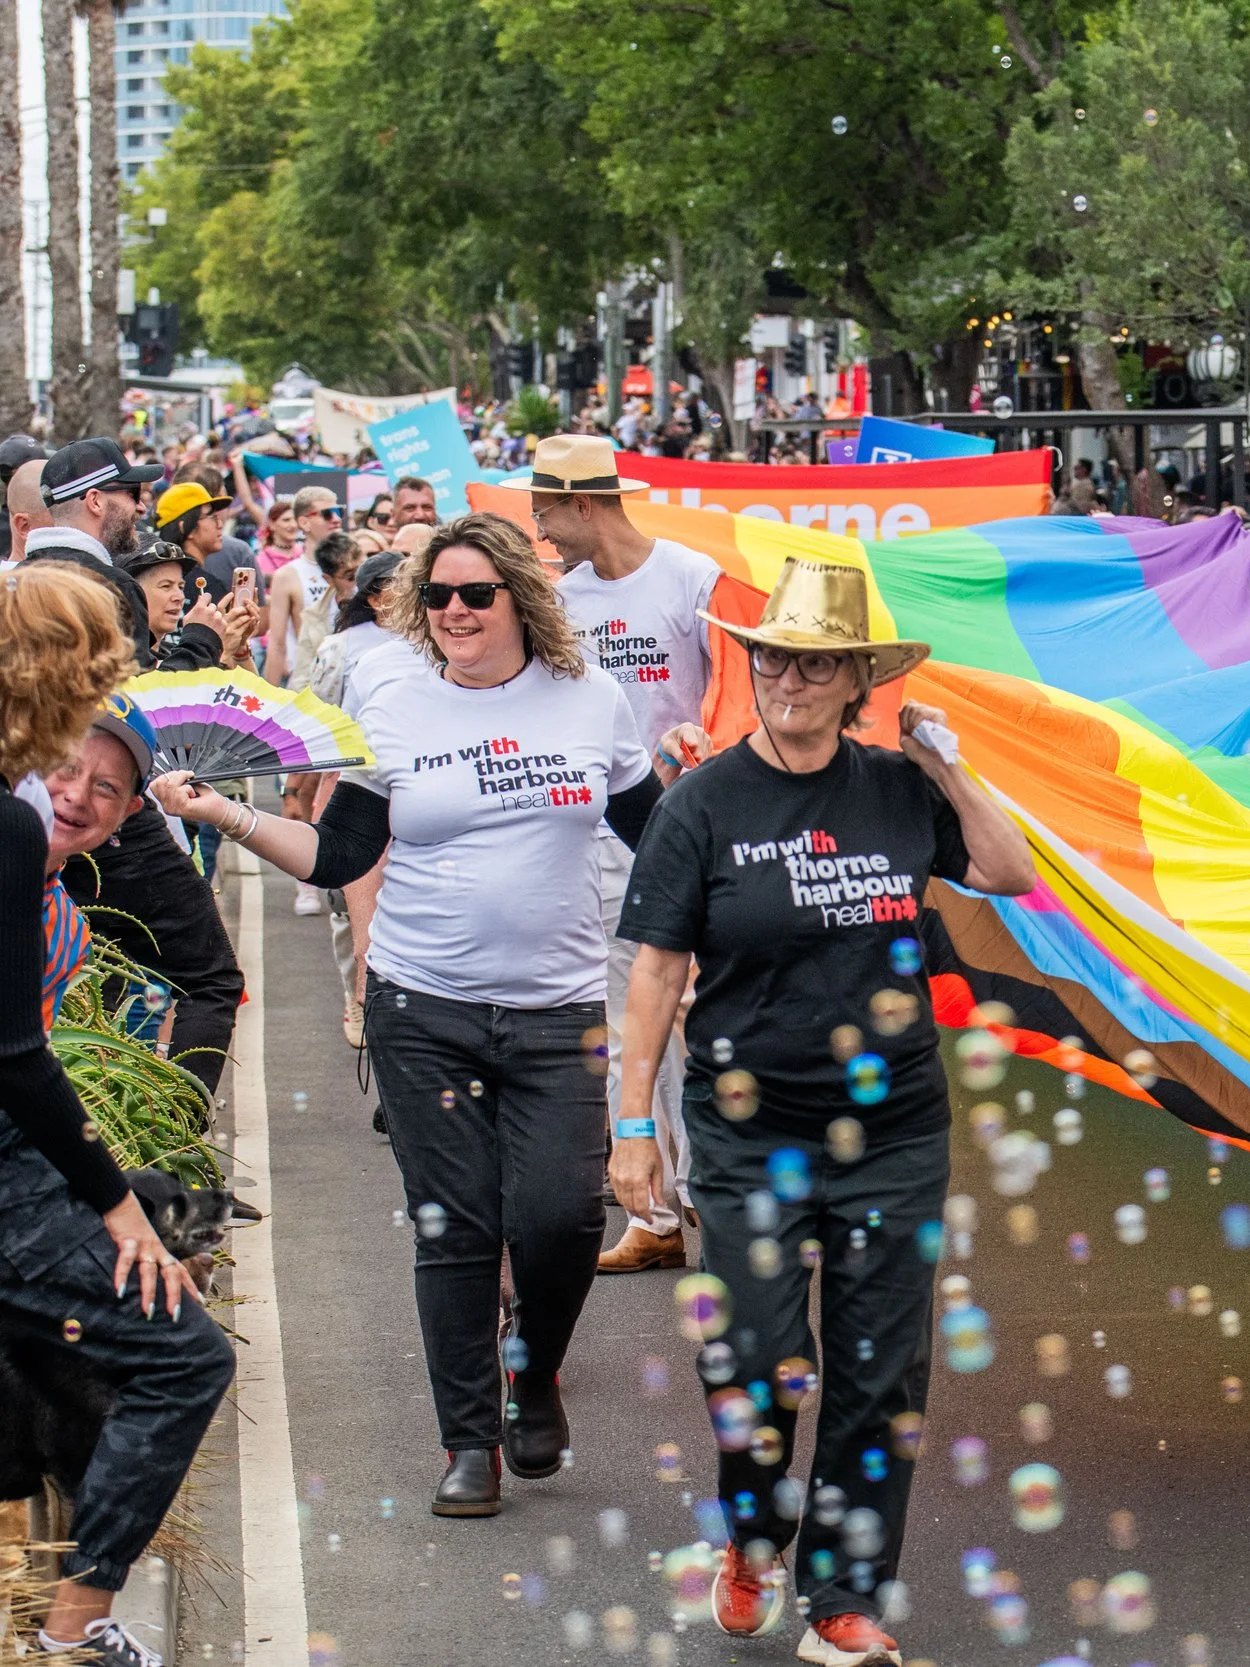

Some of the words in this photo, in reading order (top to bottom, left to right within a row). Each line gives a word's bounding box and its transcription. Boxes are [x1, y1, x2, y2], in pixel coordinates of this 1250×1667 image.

[590, 619, 627, 637] with
[598, 637, 657, 653] thorne
[599, 651, 669, 670] harbour
[414, 752, 452, 773] I'm
[458, 737, 519, 761] with
[474, 753, 567, 776] thorne
[479, 770, 587, 795] harbour
[732, 841, 777, 866] I'm
[778, 830, 838, 856] with
[785, 853, 890, 880] thorne
[790, 874, 913, 907] harbour
